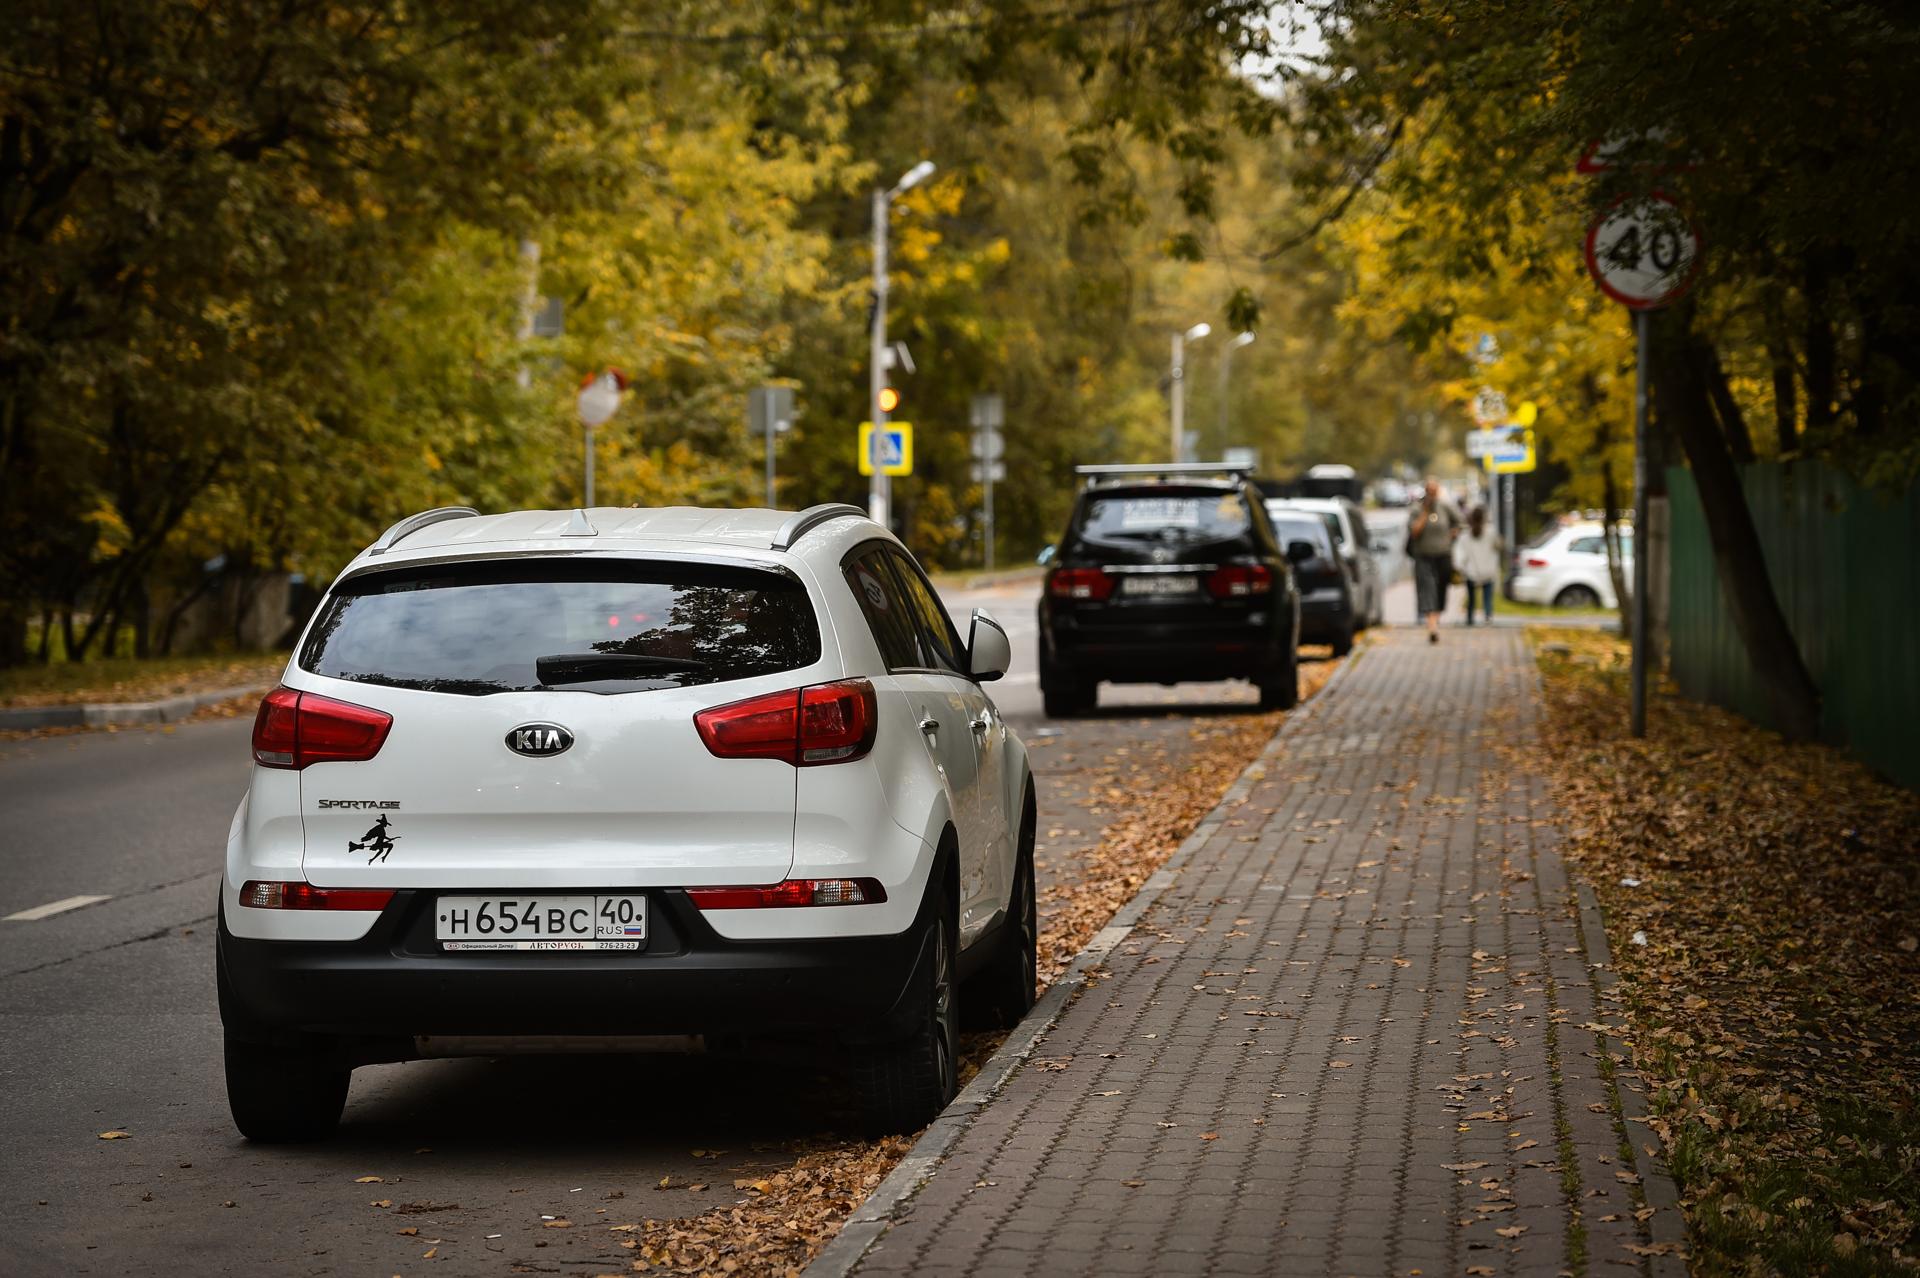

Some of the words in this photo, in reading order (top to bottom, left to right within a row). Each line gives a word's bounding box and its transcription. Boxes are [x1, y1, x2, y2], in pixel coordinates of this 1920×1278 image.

[1609, 226, 1680, 270] 40
[516, 729, 562, 750] KIA
[318, 799, 401, 810] SPORTAGE
[451, 901, 589, 934] Н654ВС
[600, 899, 634, 924] 40
[597, 925, 623, 935] RUS
